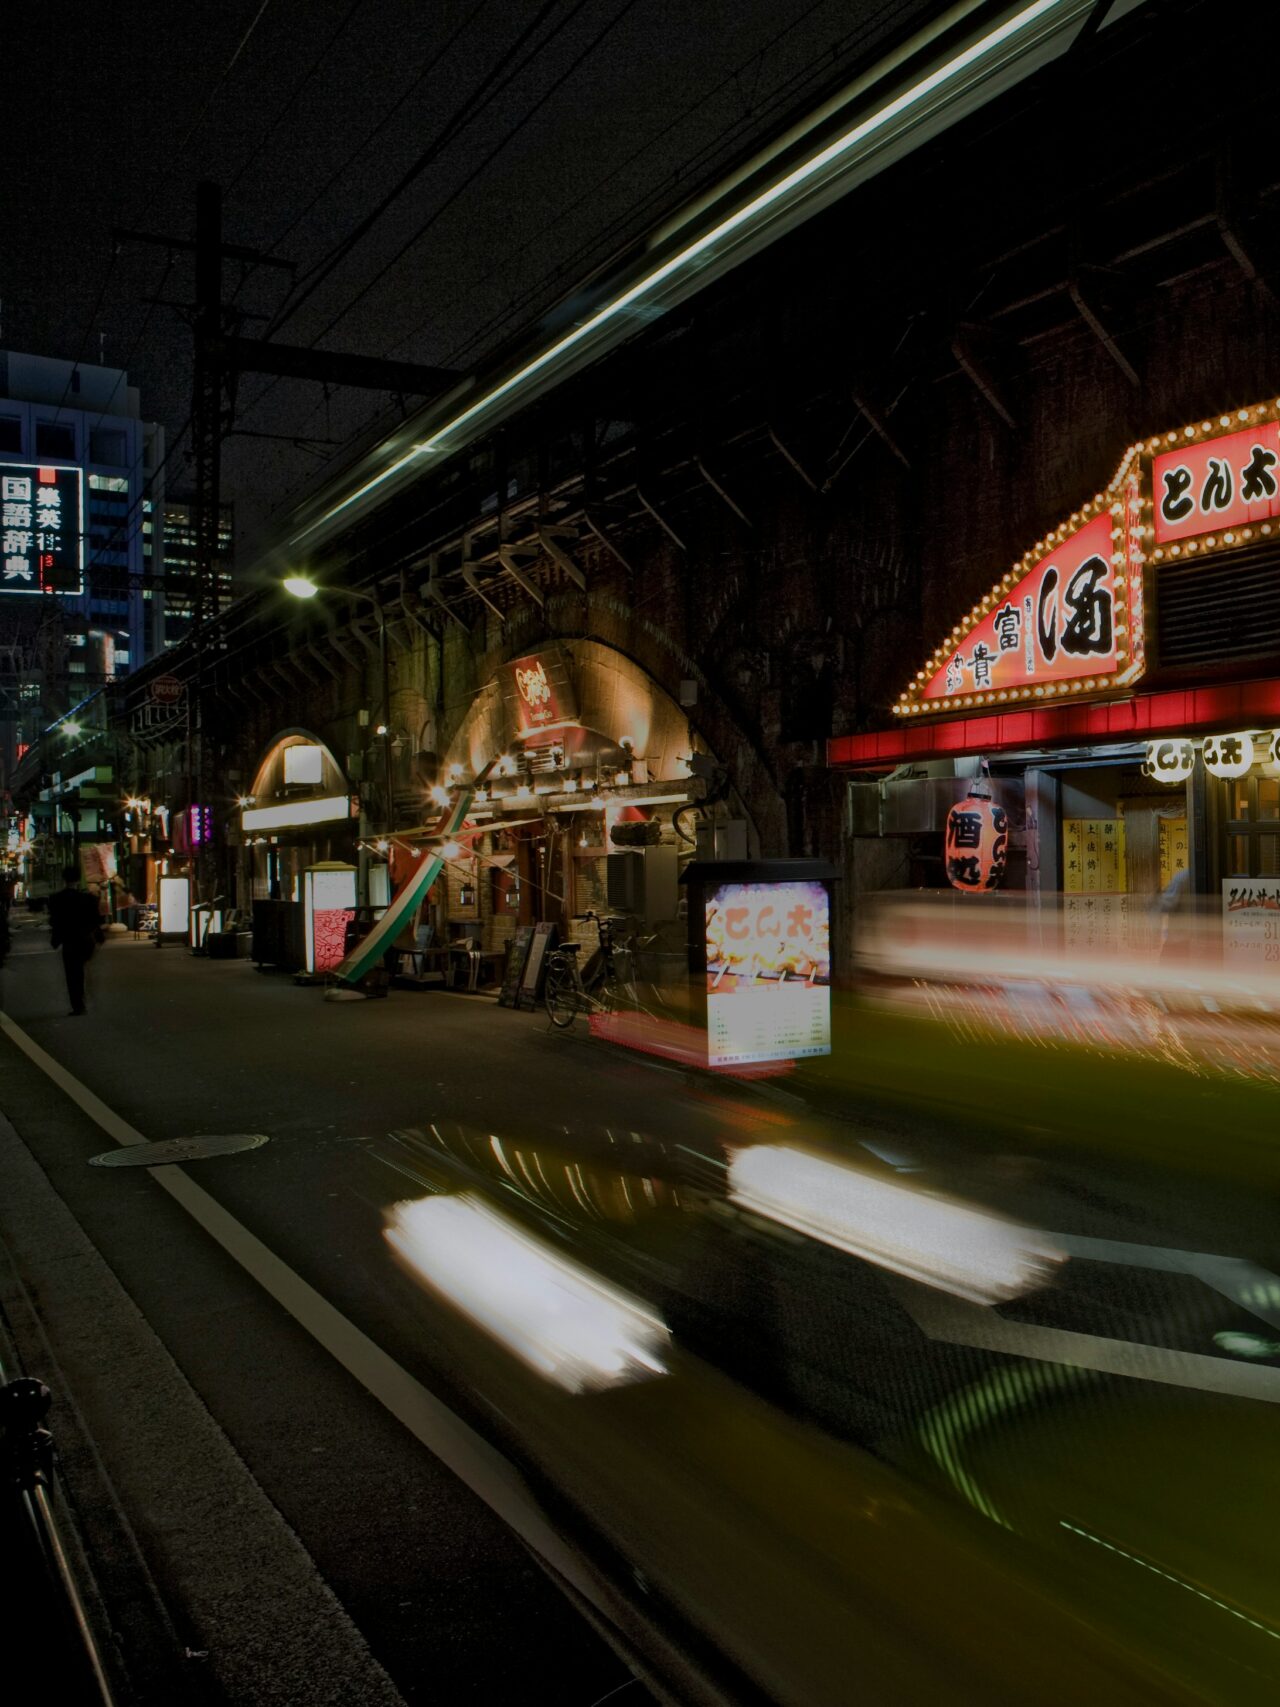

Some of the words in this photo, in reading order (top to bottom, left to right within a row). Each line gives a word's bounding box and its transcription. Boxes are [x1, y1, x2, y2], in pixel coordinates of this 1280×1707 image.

[1160, 443, 1279, 523] とん太
[2, 475, 34, 581] 国語辞典
[966, 602, 1022, 688] 富貴
[1037, 554, 1113, 664] 酒
[724, 904, 814, 941] とん太
